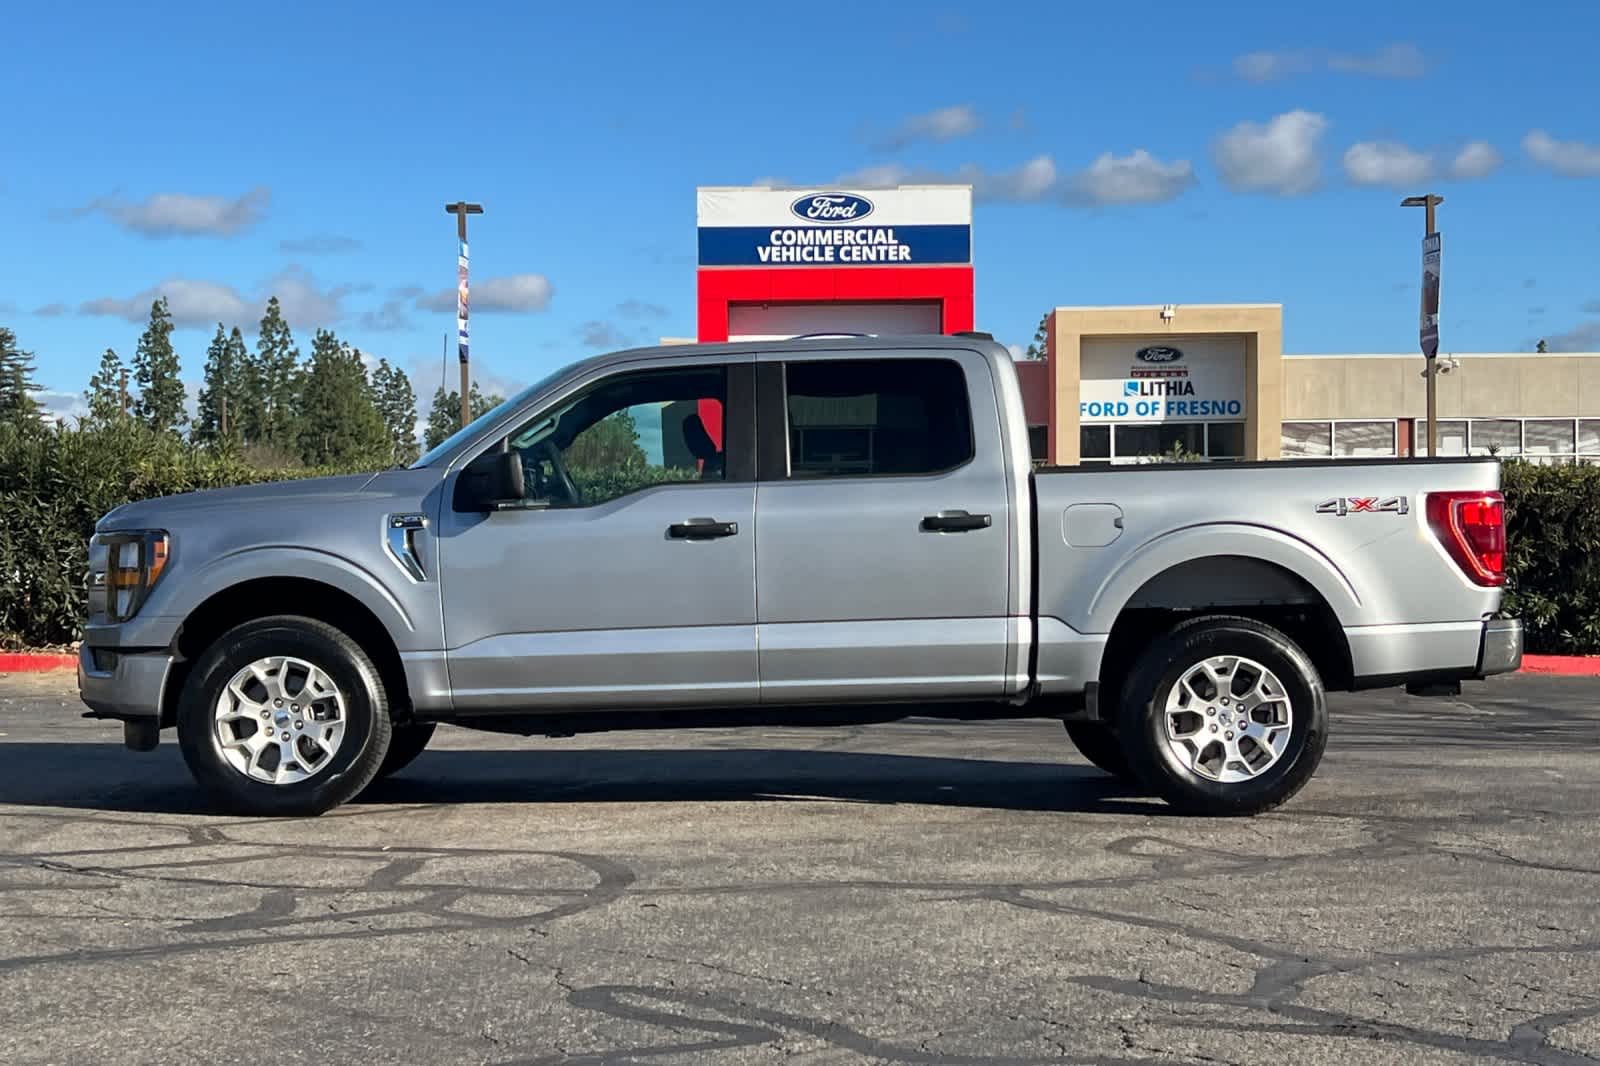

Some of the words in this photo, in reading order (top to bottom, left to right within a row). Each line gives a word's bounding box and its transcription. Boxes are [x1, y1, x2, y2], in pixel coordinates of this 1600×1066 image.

[807, 196, 858, 218] Ford
[770, 229, 898, 246] COMMERCIAL
[758, 246, 834, 262] VEHICLE
[839, 245, 911, 261] CENTER
[1144, 348, 1174, 361] Ford
[1140, 381, 1194, 396] LITHIA
[1080, 402, 1128, 416] FORD
[1135, 401, 1160, 416] OF
[1166, 400, 1241, 416] FRESNO
